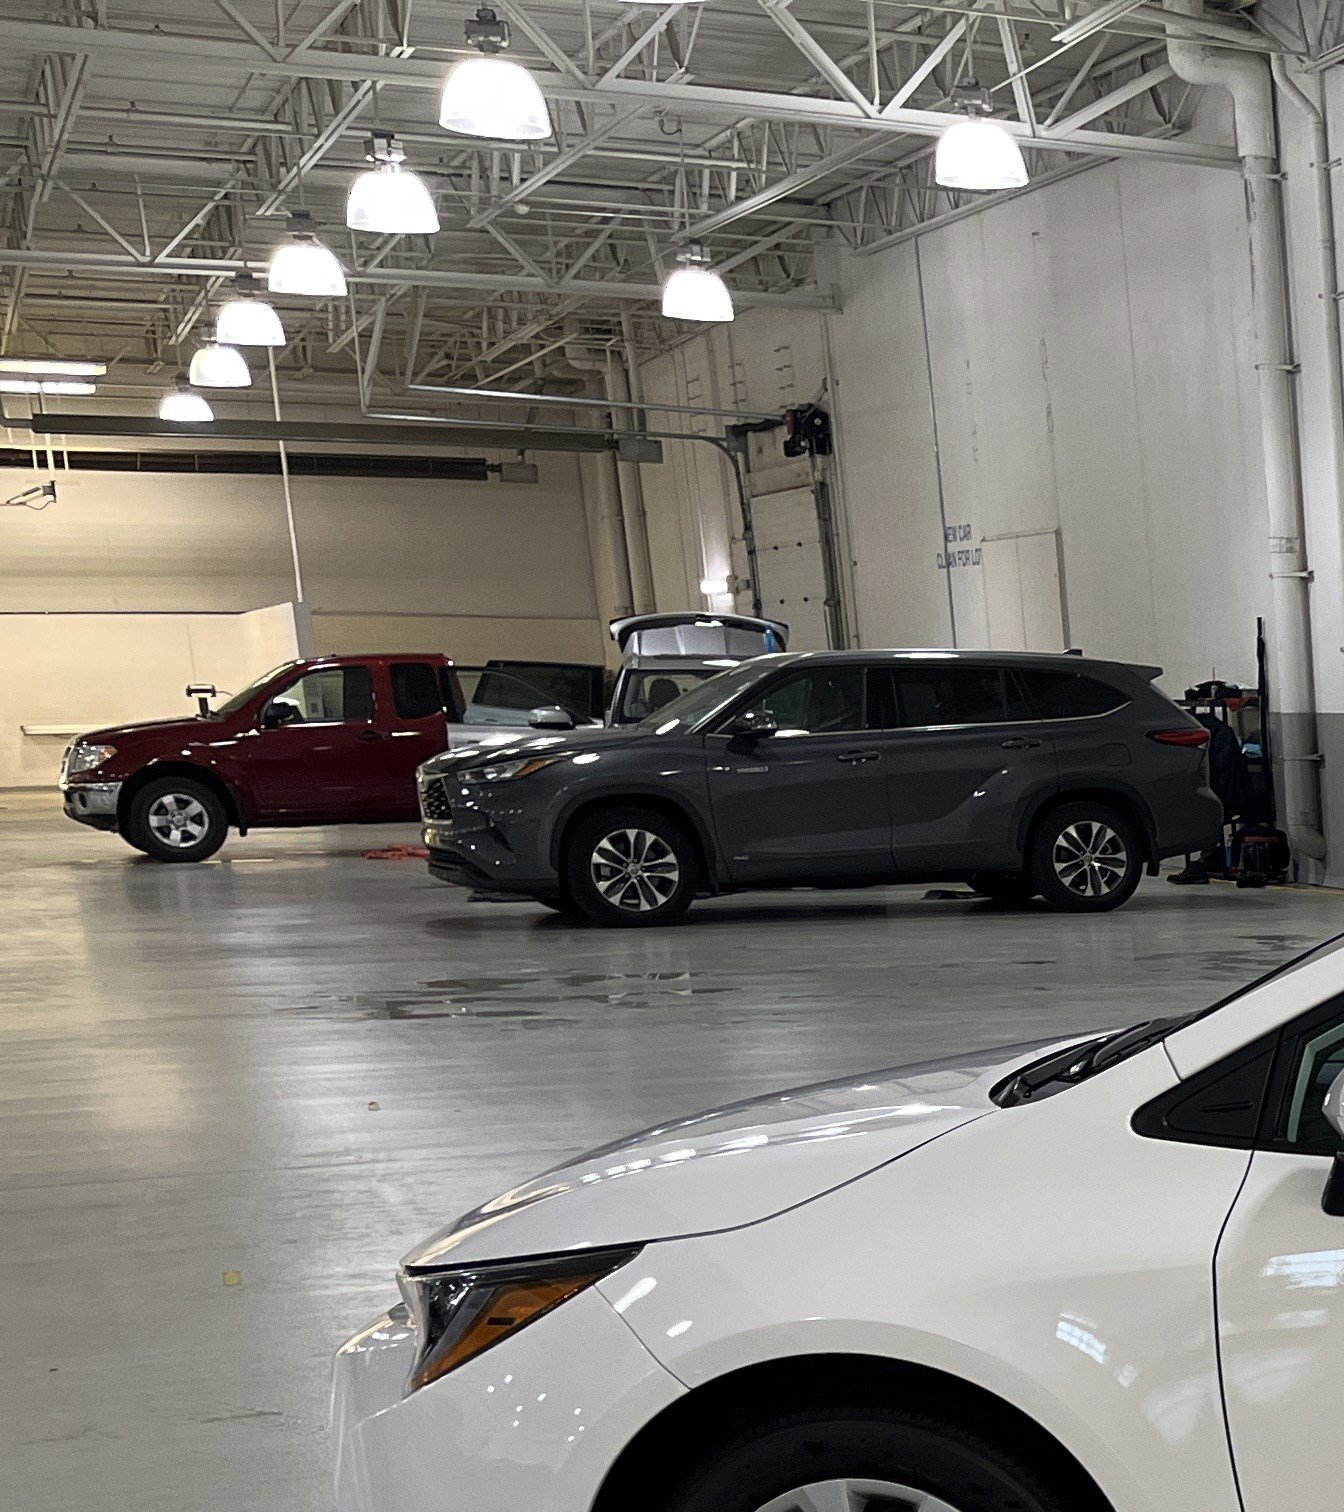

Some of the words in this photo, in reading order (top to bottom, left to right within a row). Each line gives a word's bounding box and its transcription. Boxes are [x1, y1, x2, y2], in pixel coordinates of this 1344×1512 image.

[958, 524, 972, 541] CAR
[936, 551, 957, 569] CLAN
[957, 549, 970, 567] FOR
[970, 547, 982, 566] LOT
